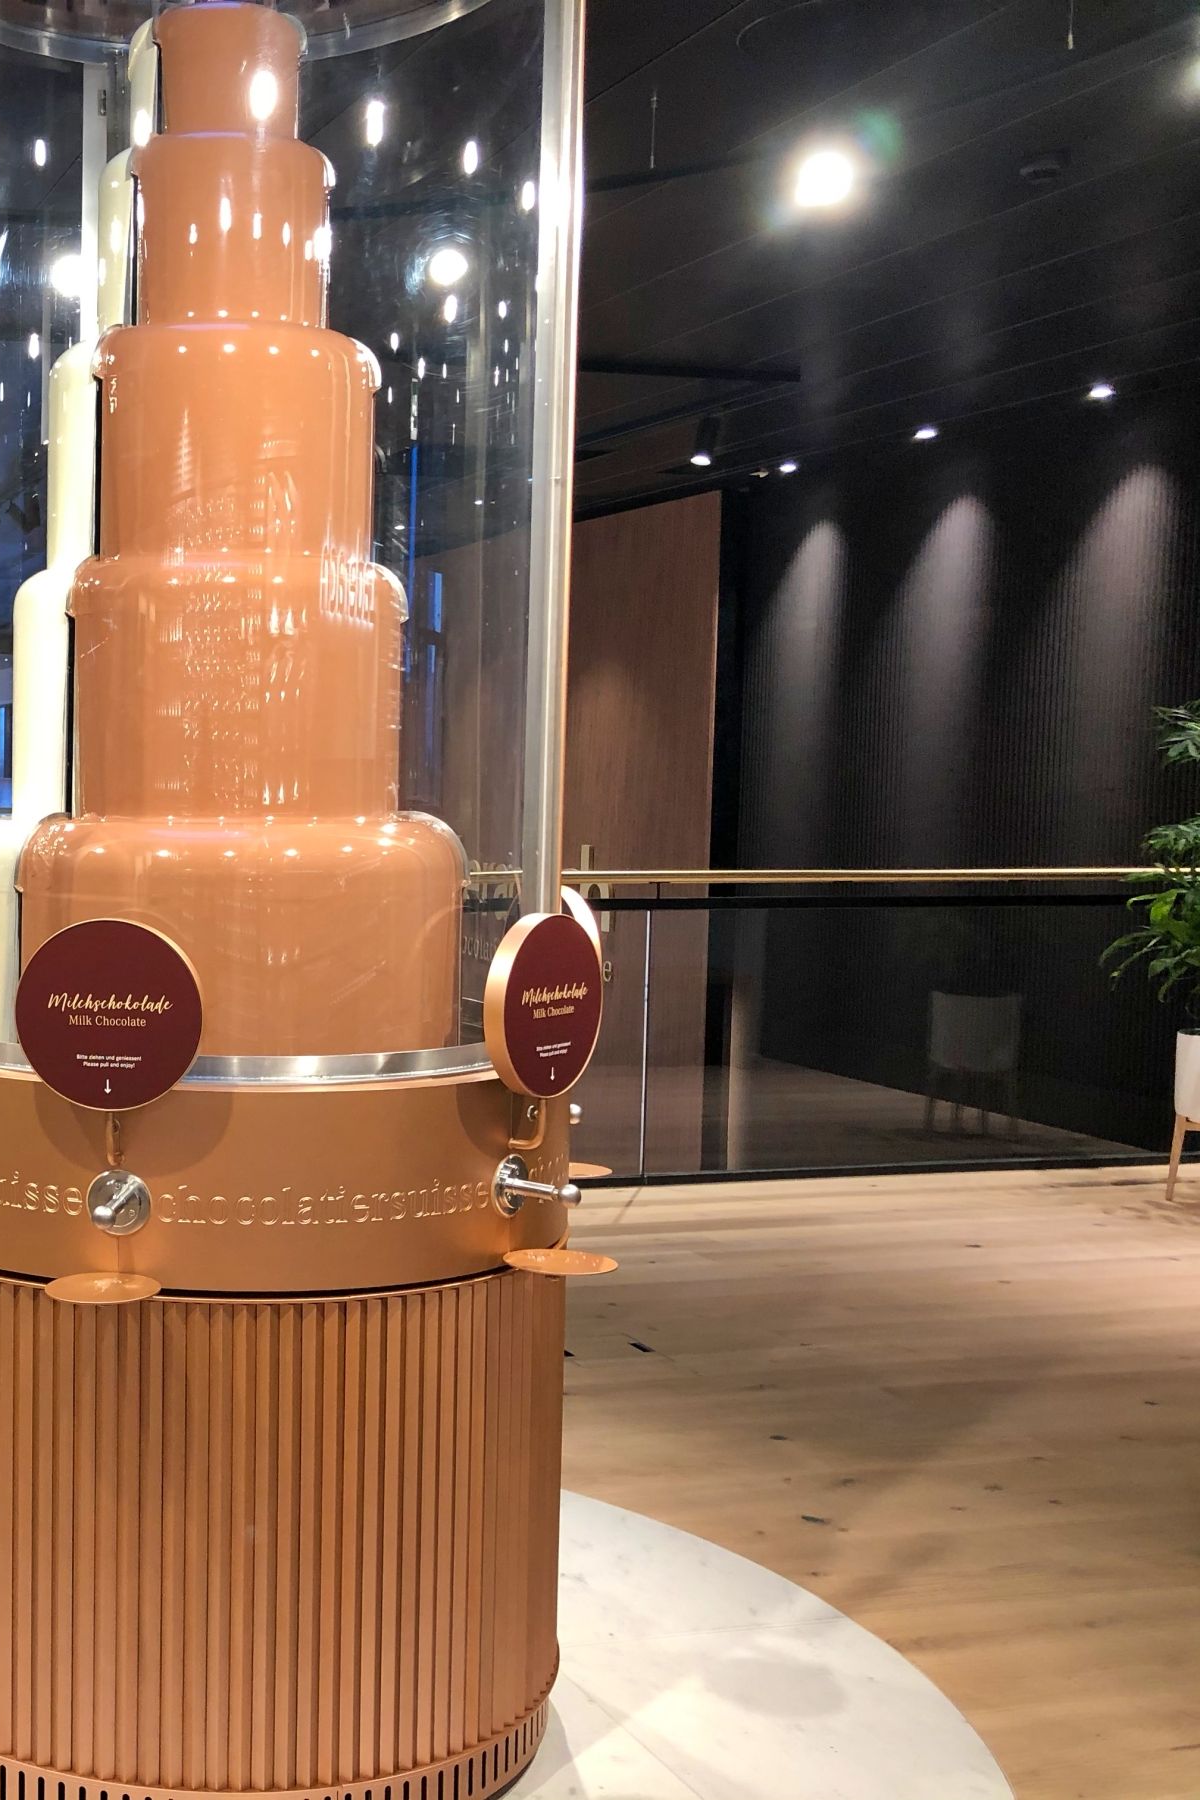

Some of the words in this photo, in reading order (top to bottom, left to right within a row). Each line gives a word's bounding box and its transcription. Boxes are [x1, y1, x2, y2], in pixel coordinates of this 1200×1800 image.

[521, 982, 588, 1008] Milchschokolade
[48, 992, 173, 1015] Milchschokolade
[533, 1008, 546, 1019] Milk
[547, 1005, 575, 1017] Chocolate
[68, 1014, 93, 1026] Milk
[95, 1015, 147, 1027] Chocolate
[76, 1053, 88, 1061] Bitte
[82, 1060, 99, 1068] Please
[99, 1061, 110, 1069] pull
[120, 1062, 136, 1070] enjoy!
